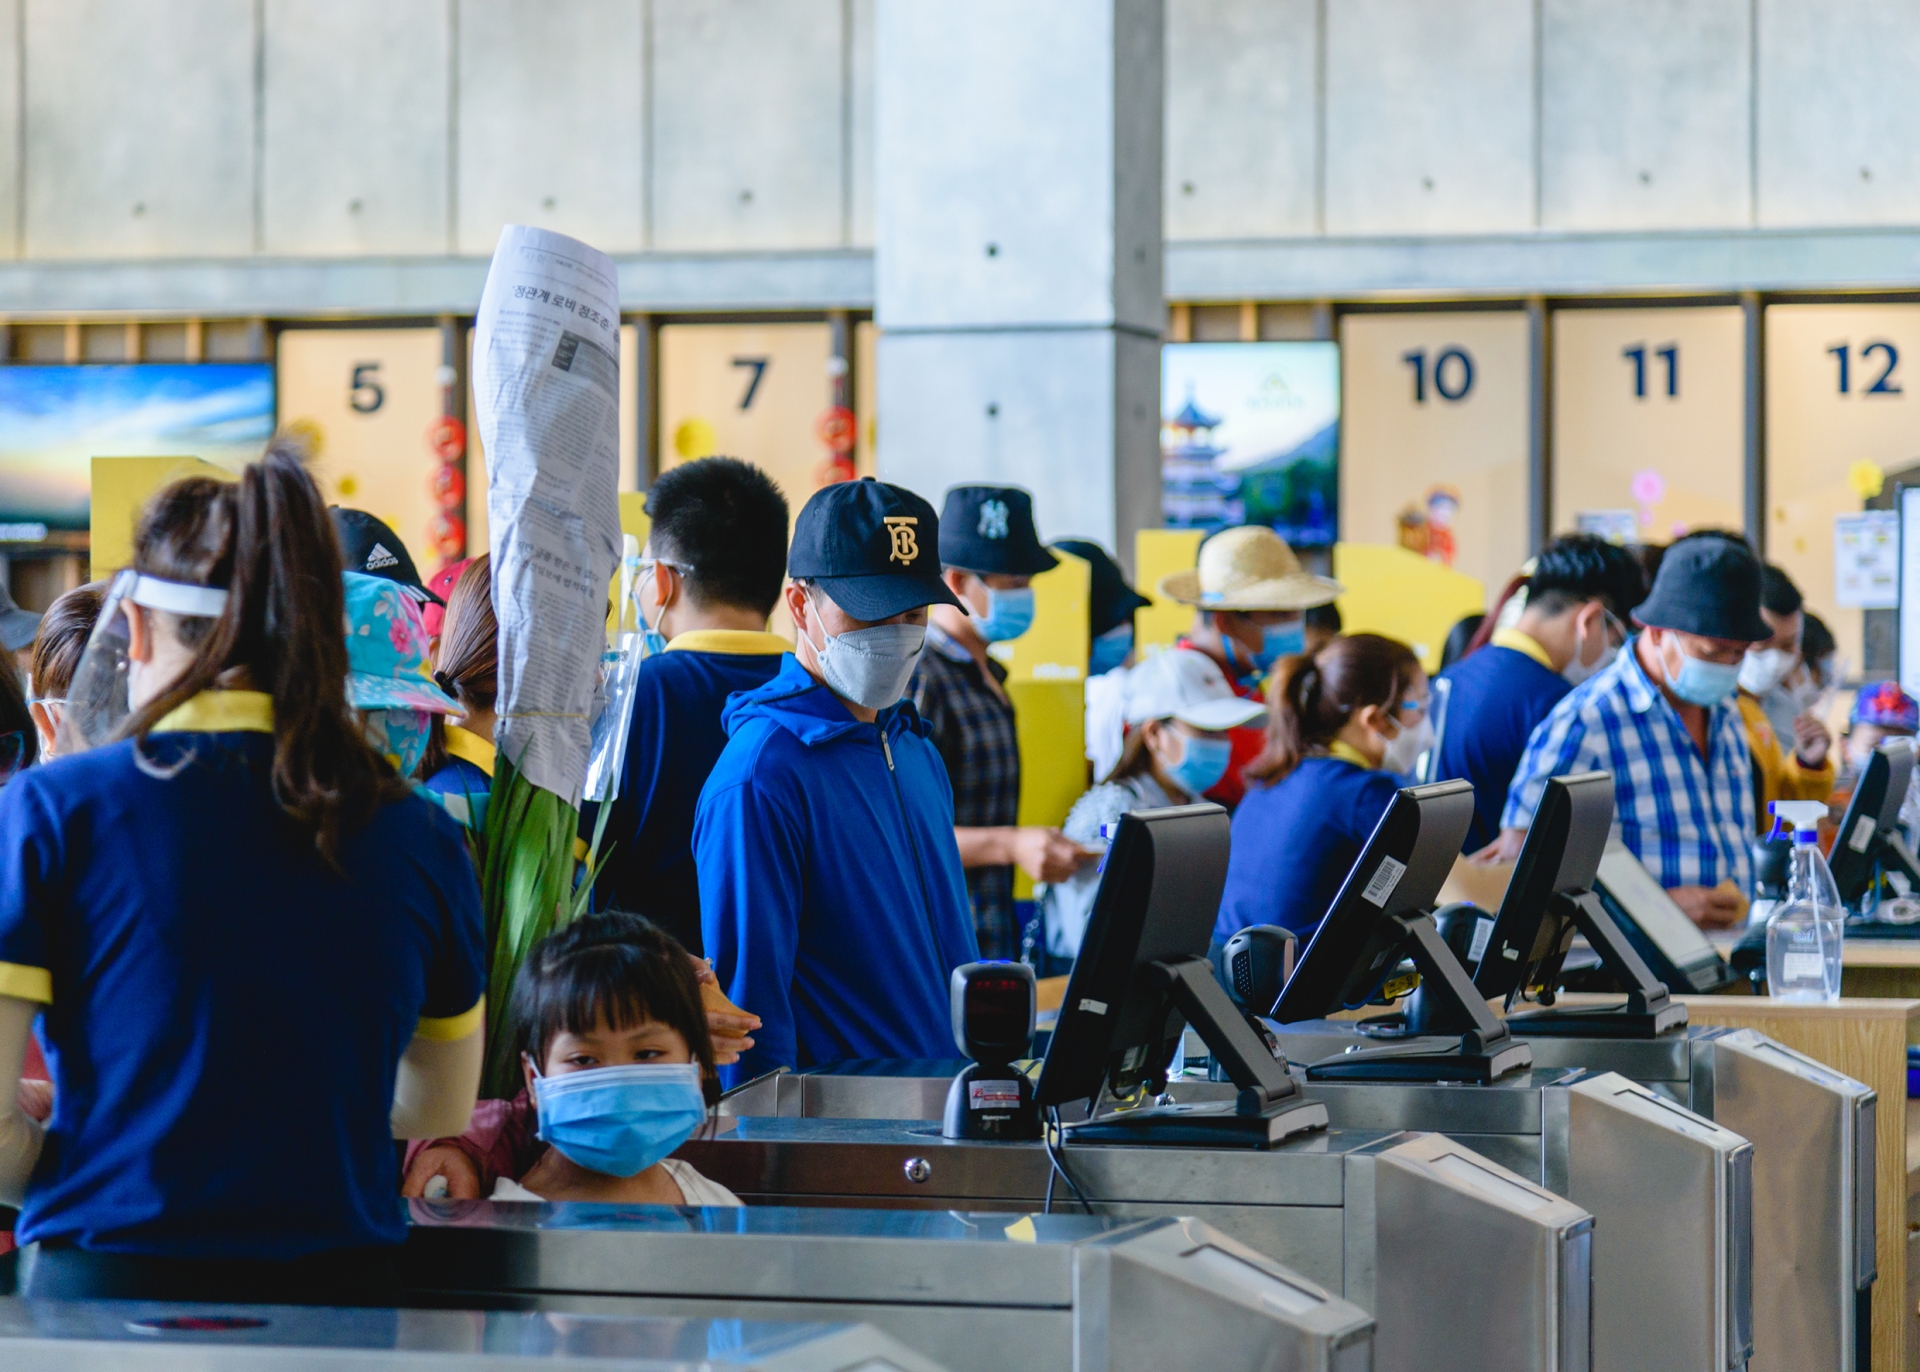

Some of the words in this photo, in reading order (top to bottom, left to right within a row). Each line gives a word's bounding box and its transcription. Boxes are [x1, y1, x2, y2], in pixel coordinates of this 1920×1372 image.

[551, 293, 577, 313] 로비
[350, 361, 385, 415] 5
[731, 356, 769, 410] 7
[1403, 349, 1474, 402] 10
[1622, 345, 1677, 398] 11
[1827, 342, 1903, 394] 12
[366, 556, 399, 571] adidas
